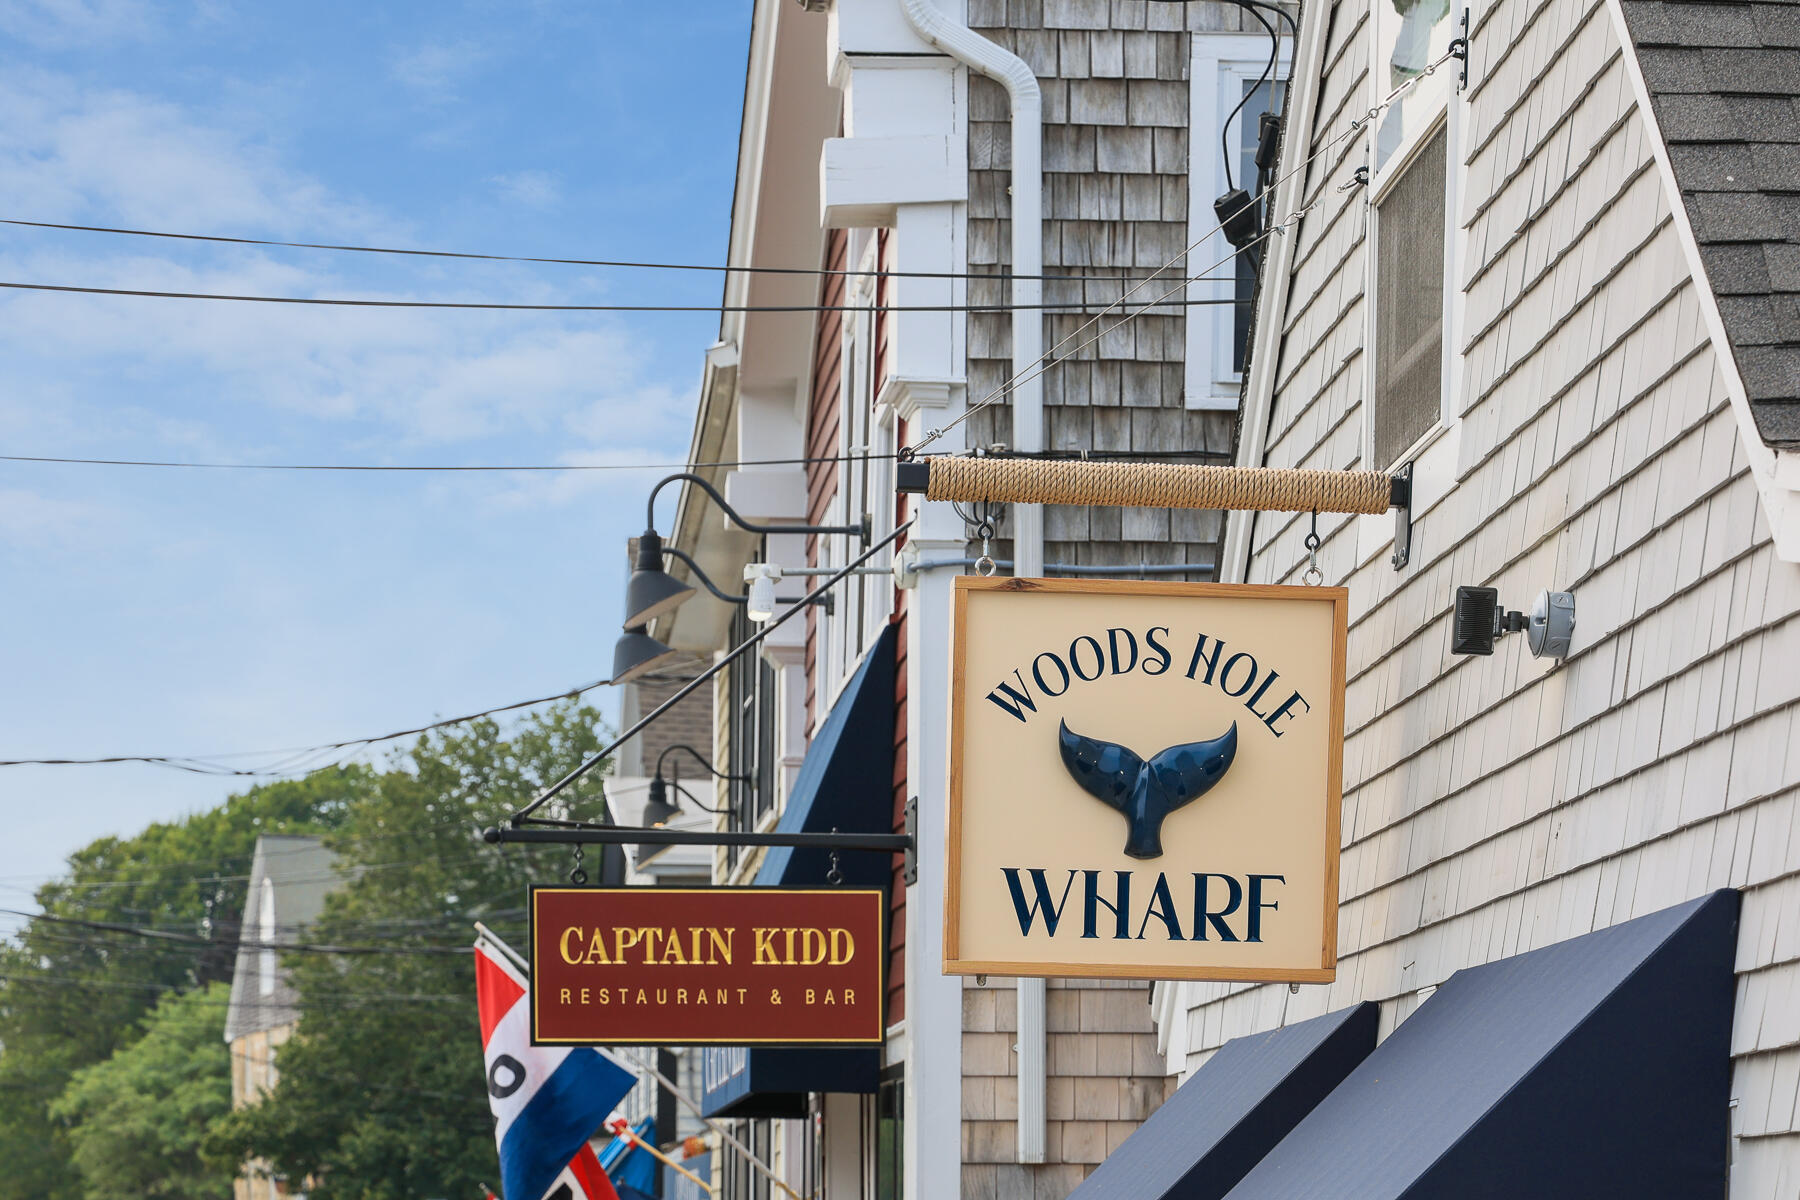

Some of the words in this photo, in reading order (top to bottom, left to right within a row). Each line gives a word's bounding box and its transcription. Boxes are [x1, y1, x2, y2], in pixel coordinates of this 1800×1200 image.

[985, 626, 1172, 723] WOODS
[1184, 632, 1311, 738] HOLE
[1000, 867, 1287, 943] WHARF
[559, 926, 736, 966] CAPTAIN
[752, 927, 856, 966] KIDD
[560, 988, 748, 1005] RESTAURANT
[770, 989, 783, 1005] &
[805, 988, 857, 1005] BAR
